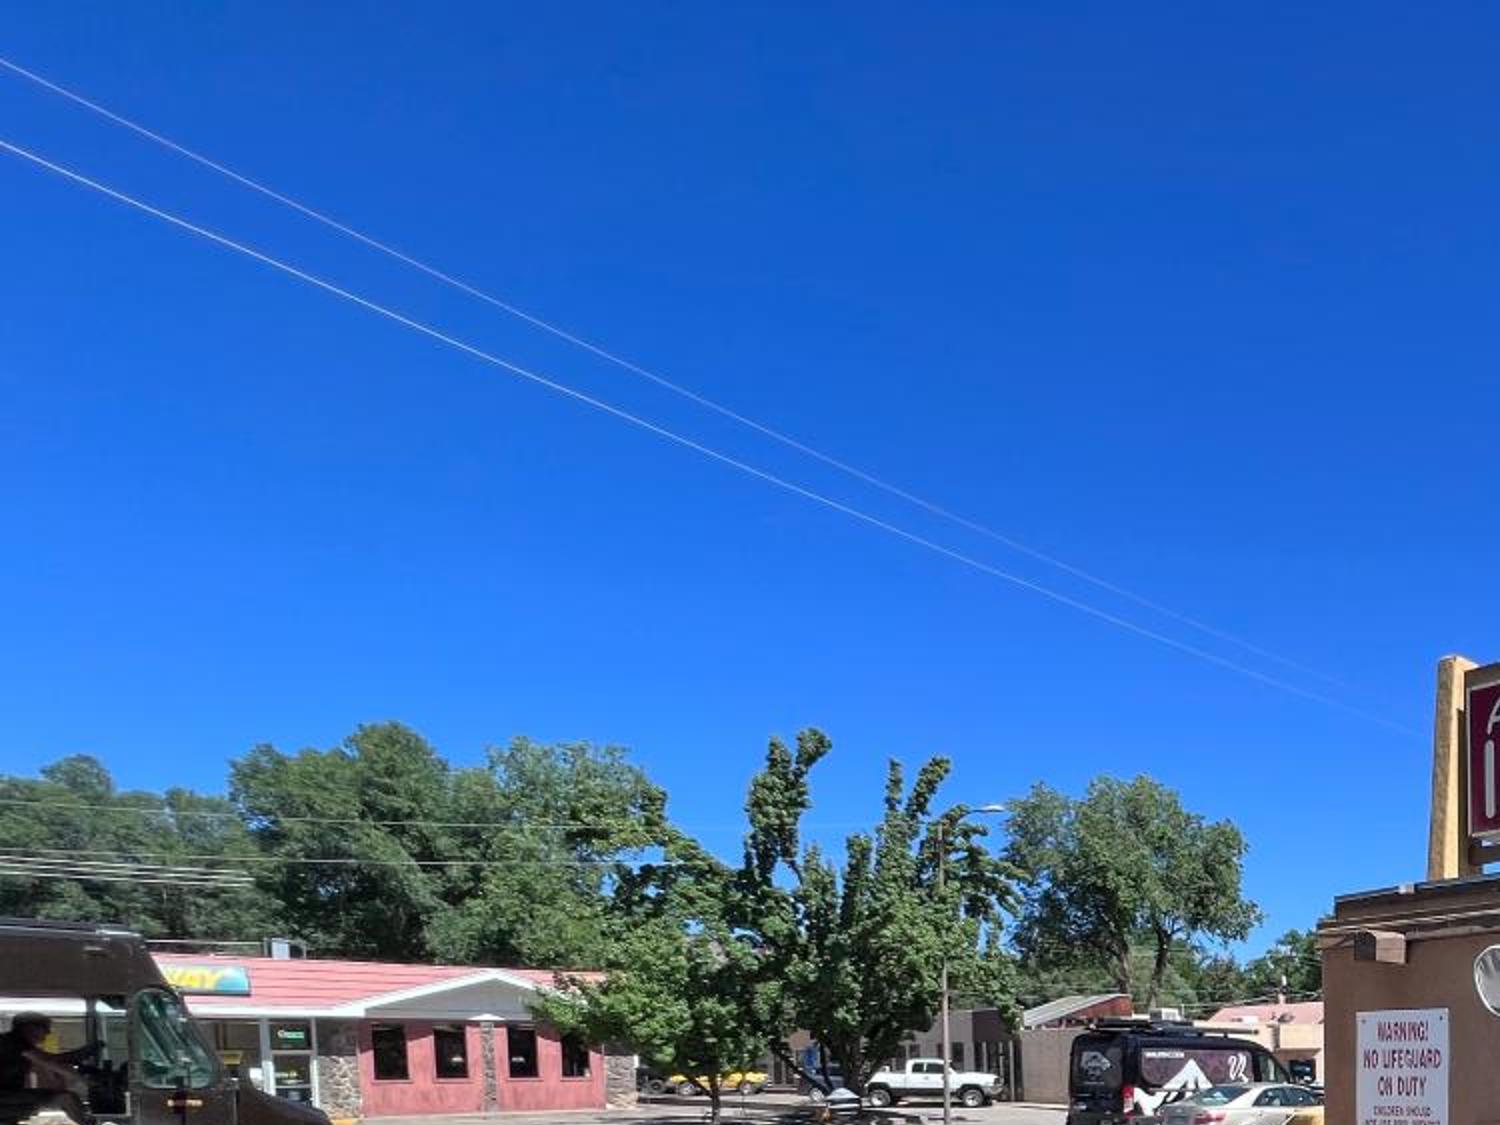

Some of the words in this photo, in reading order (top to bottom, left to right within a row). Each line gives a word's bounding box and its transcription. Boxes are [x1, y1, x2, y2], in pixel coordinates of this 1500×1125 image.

[1378, 1020, 1428, 1041] WARNING!
[1364, 1049, 1378, 1069] NO
[1383, 1048, 1441, 1069] LIFEGUARD
[1378, 1076, 1392, 1096] ON
[1397, 1076, 1426, 1096] DUTY
